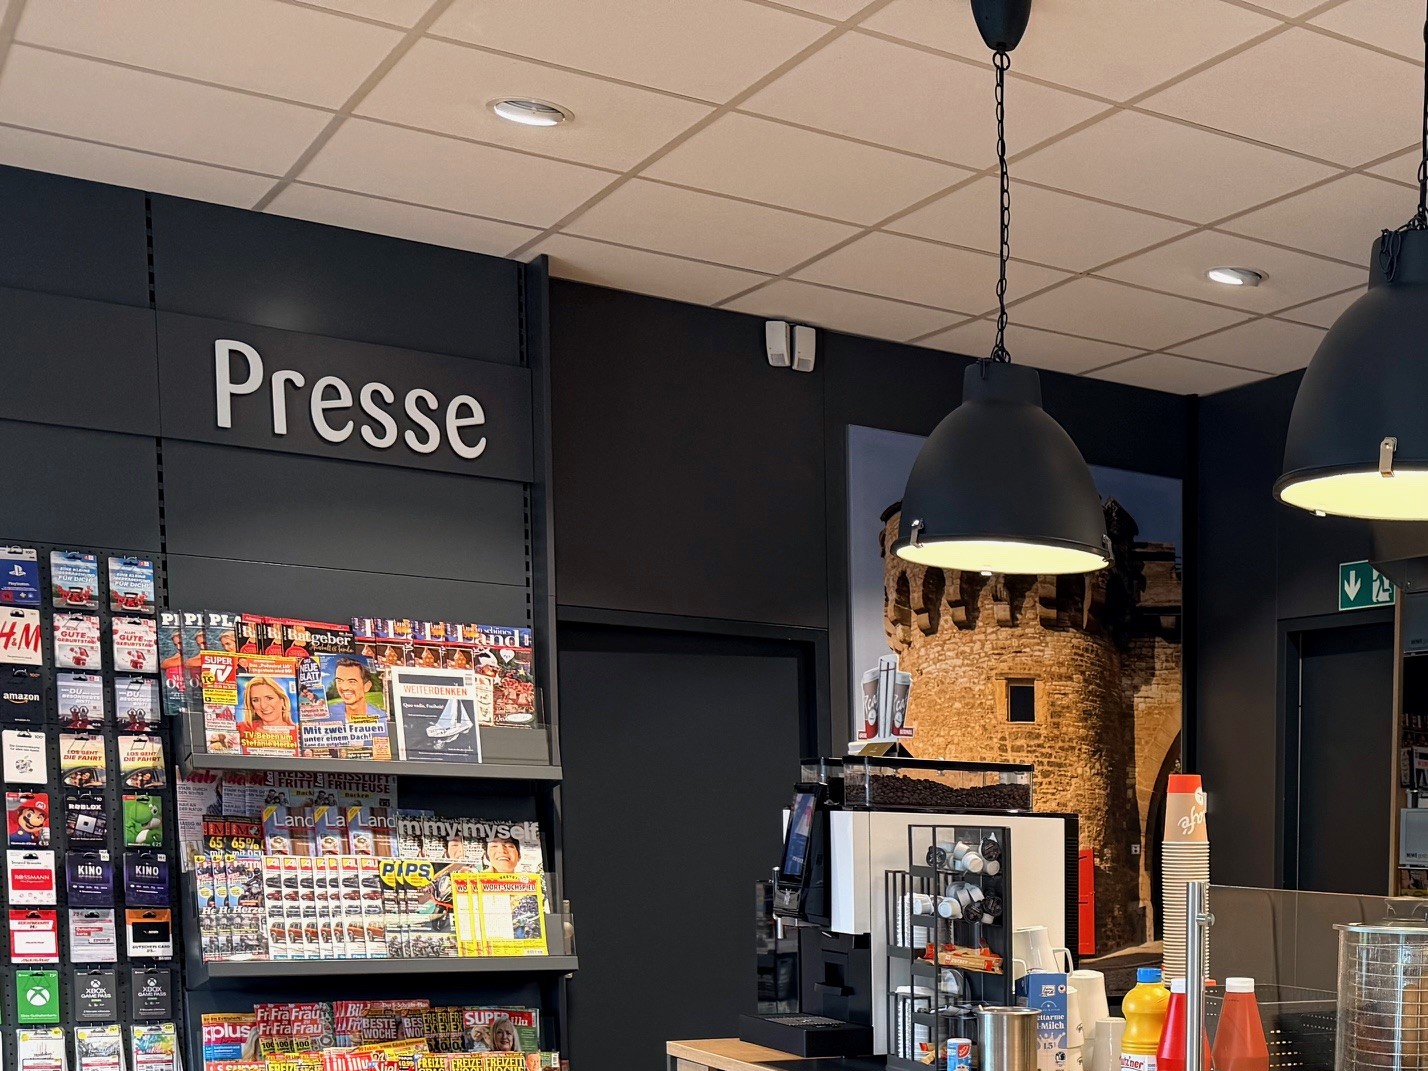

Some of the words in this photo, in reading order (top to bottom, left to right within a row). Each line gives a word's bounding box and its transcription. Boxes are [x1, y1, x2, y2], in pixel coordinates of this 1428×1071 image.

[214, 339, 487, 459] Presse
[0, 620, 40, 653] H&M
[60, 630, 87, 639] GUTE
[119, 634, 144, 643] GUTE
[288, 628, 351, 646] Ratgeber
[204, 656, 233, 665] SUPER
[202, 664, 233, 682] TV
[300, 664, 319, 673] NEUE
[300, 673, 320, 683] BLATT
[403, 685, 468, 696] WEITERDENKEN
[3, 692, 40, 702] amazon
[303, 726, 321, 735] Mit
[324, 726, 347, 735] zwei
[349, 723, 384, 734] Frauen
[350, 733, 372, 741] Dach!
[77, 754, 102, 762] FAHRT
[137, 755, 162, 763] FAHRT
[328, 780, 390, 793] FRITTEUSE
[68, 803, 102, 811] ROBLOX
[463, 820, 539, 842] myself
[77, 865, 103, 876] KINO
[135, 865, 159, 876] KINO
[405, 864, 431, 879] PS
[293, 1023, 321, 1035] Frau
